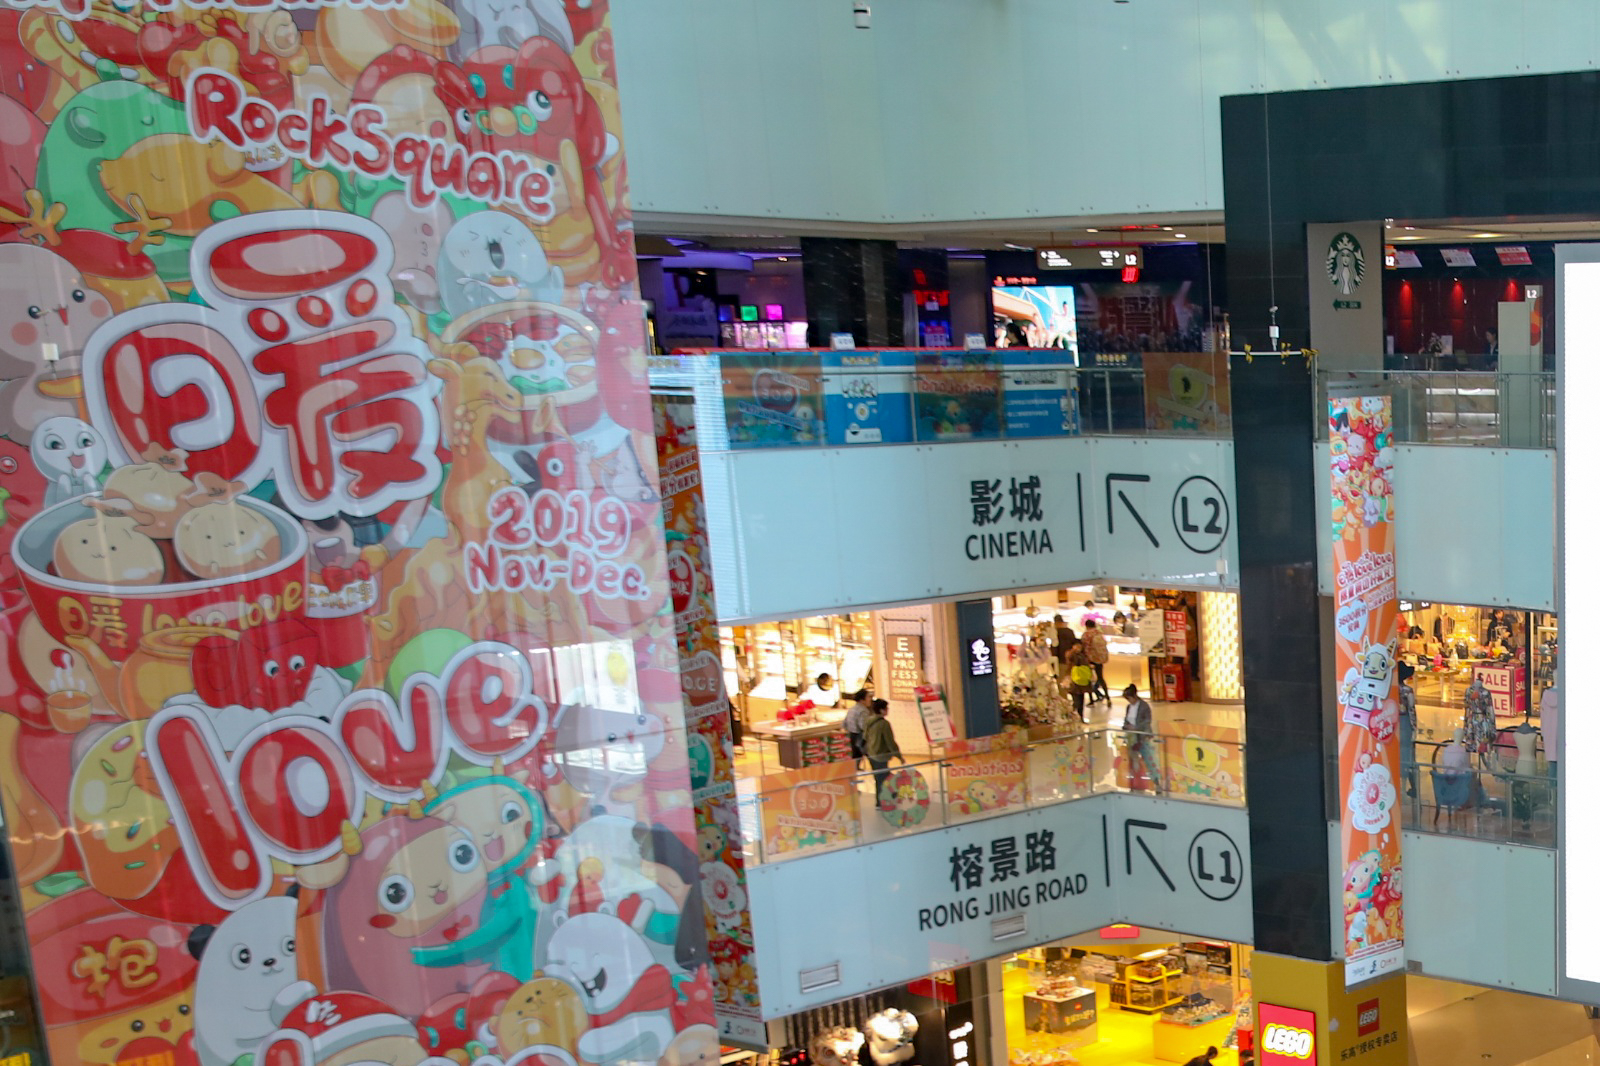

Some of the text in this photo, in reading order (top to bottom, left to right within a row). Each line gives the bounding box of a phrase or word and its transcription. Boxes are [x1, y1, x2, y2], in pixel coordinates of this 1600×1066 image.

[487, 489, 632, 549] 2019
[969, 475, 1043, 527] 影城
[1180, 496, 1223, 536] L2
[965, 529, 1053, 562] CINEMA
[896, 637, 909, 651] E
[1494, 699, 1509, 711] LE
[1515, 680, 1526, 692] SAL
[148, 643, 542, 904] love
[949, 828, 1058, 893] 榕景路
[1197, 845, 1236, 885] L1
[918, 872, 1088, 932] RONG JING ROAD
[1359, 1008, 1378, 1027] LEGO
[1264, 1024, 1313, 1058] LEGO
